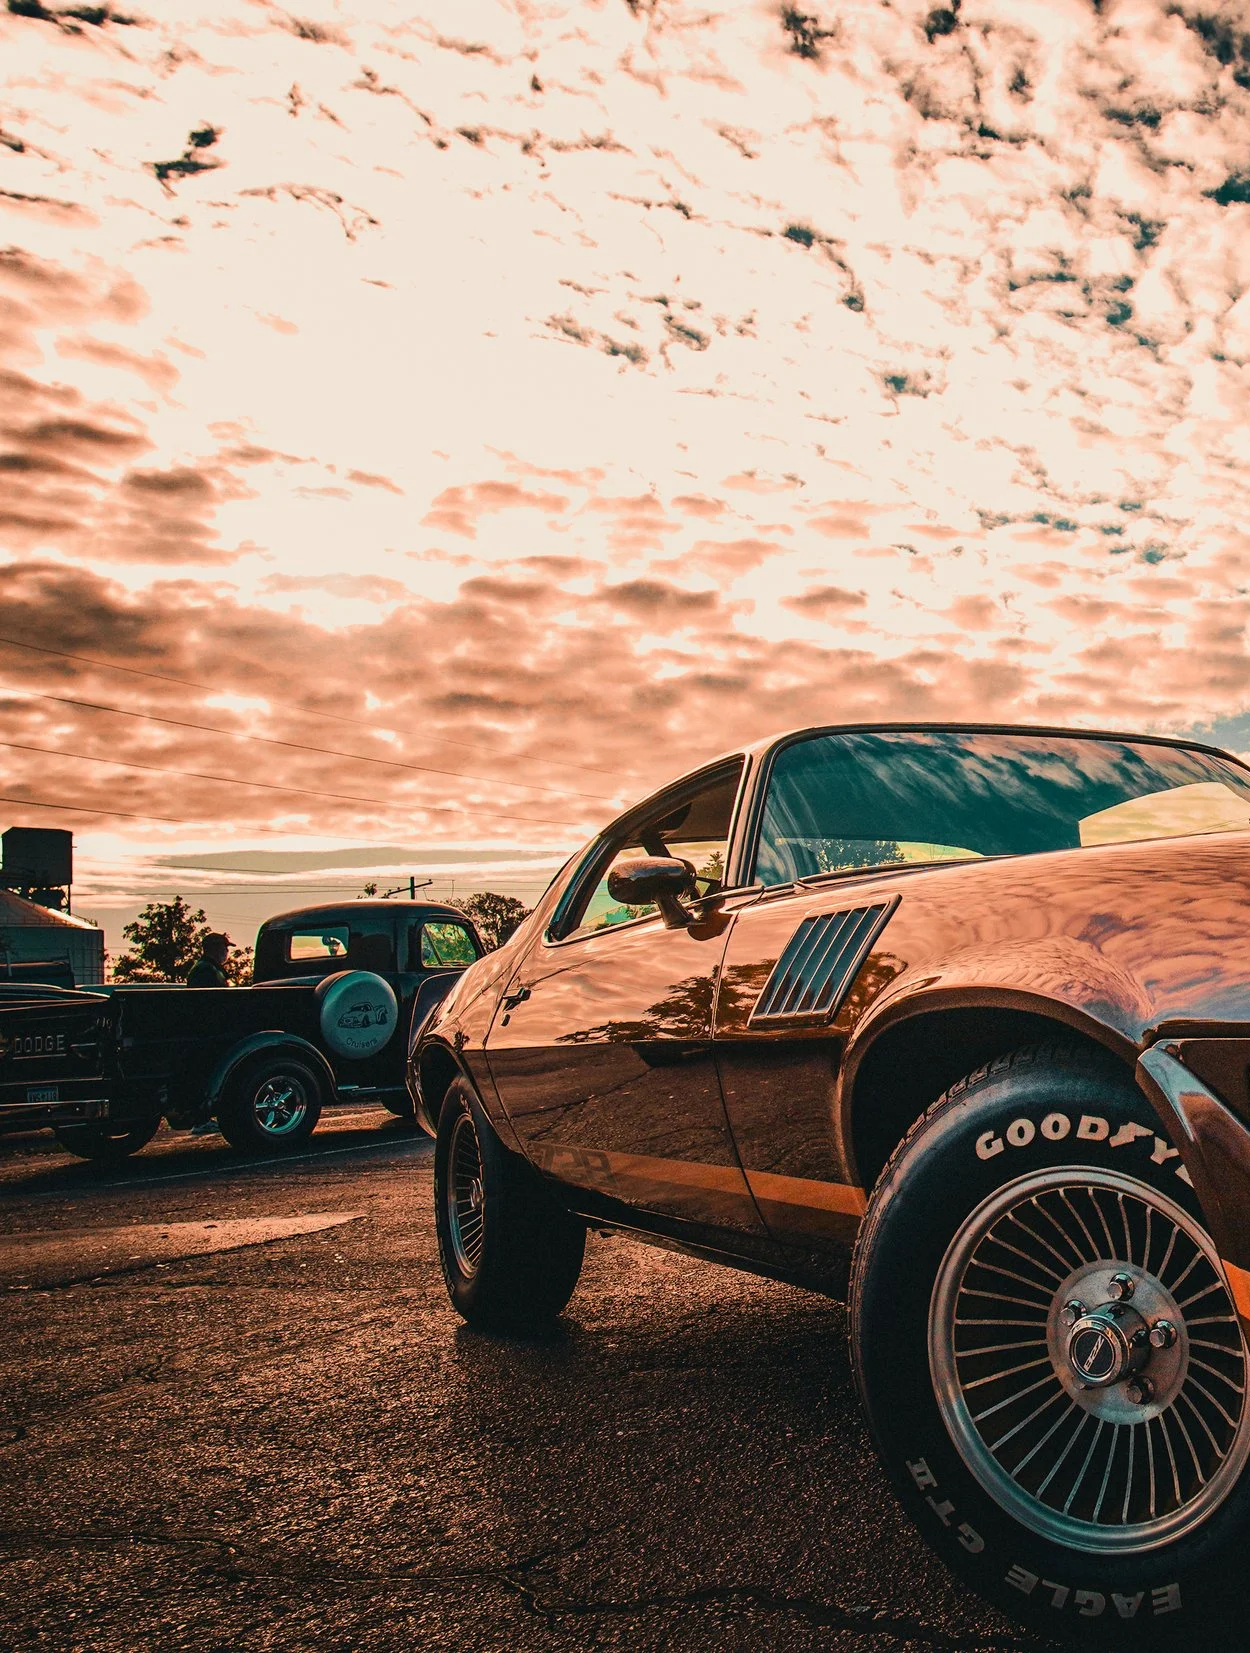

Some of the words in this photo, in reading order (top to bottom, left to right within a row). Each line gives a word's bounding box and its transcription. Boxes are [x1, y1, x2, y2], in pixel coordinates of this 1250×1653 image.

[14, 1034, 65, 1054] DODGE
[974, 1112, 1195, 1190] GOODY
[1004, 1563, 1183, 1619] EAGLE
